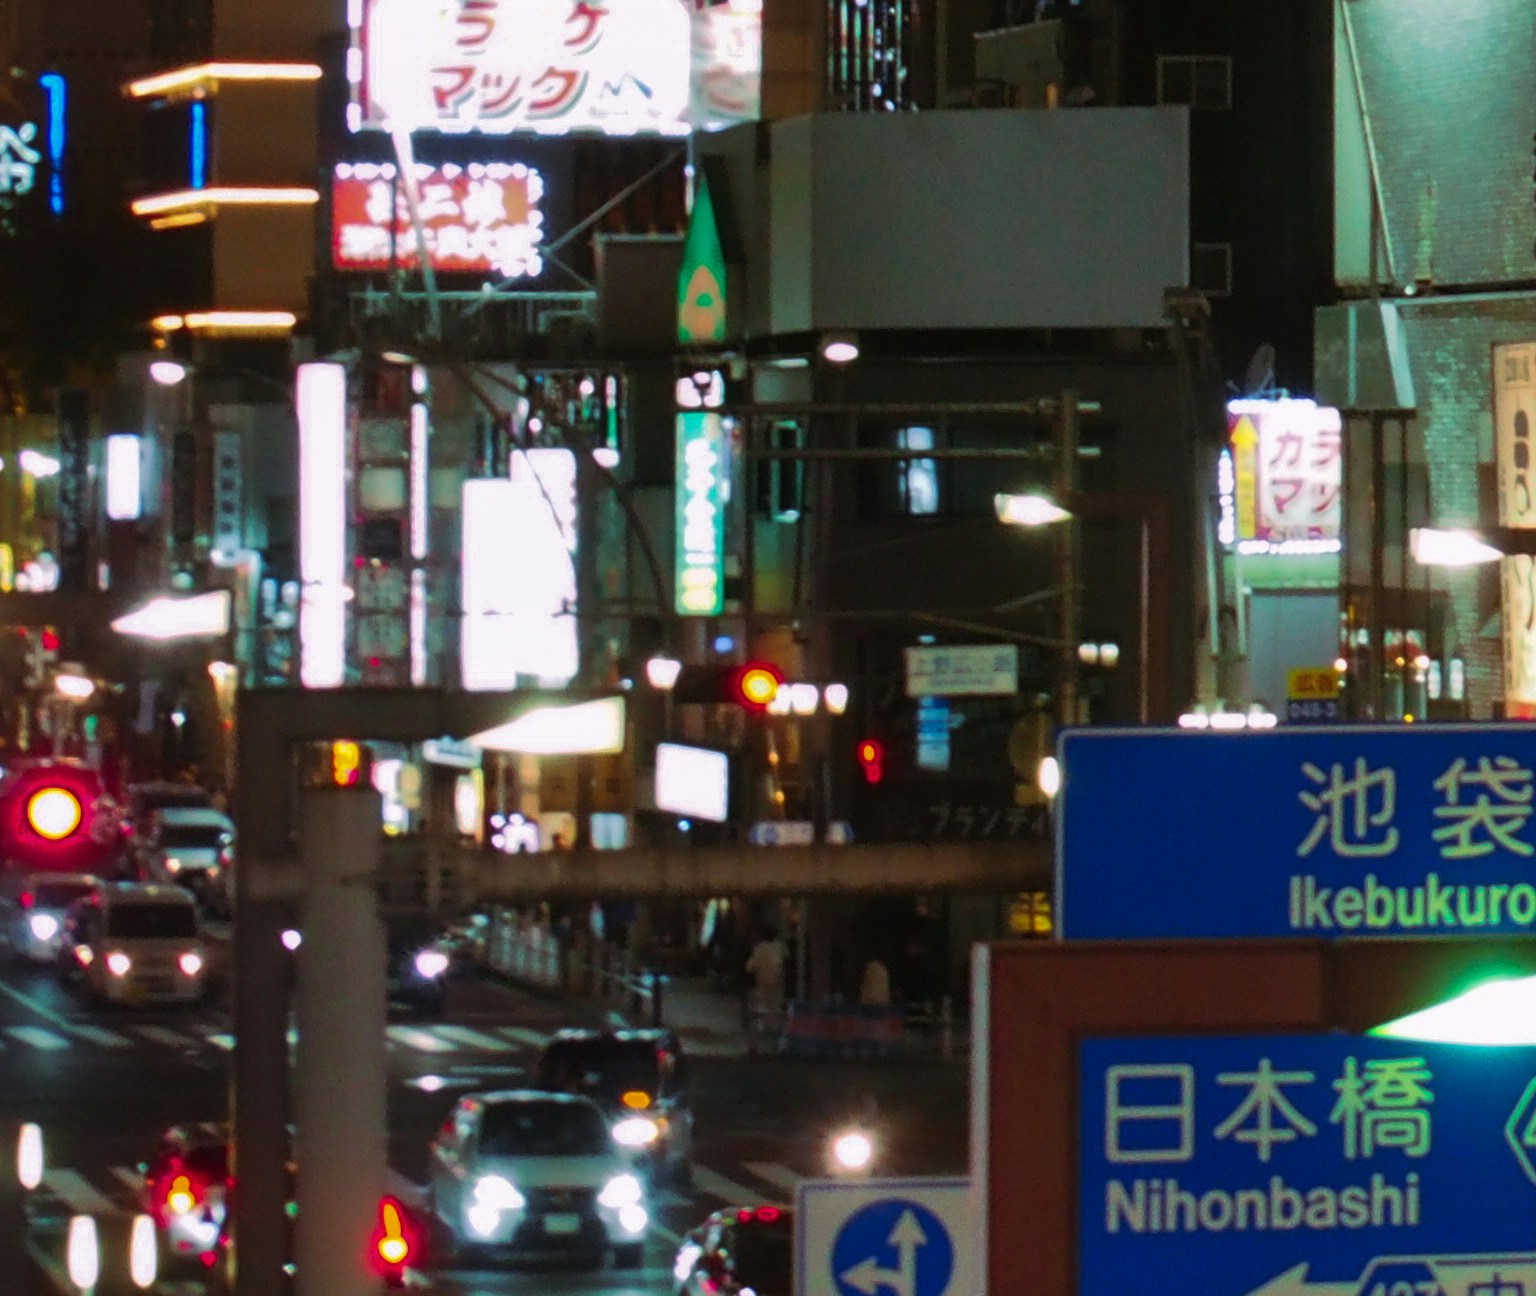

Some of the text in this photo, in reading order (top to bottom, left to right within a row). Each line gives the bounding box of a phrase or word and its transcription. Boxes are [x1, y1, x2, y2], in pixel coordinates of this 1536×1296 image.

[1296, 756, 1536, 859] 池袋
[1105, 1055, 1435, 1163] 日本橋
[1104, 1172, 1421, 1233] Nihonbashi
